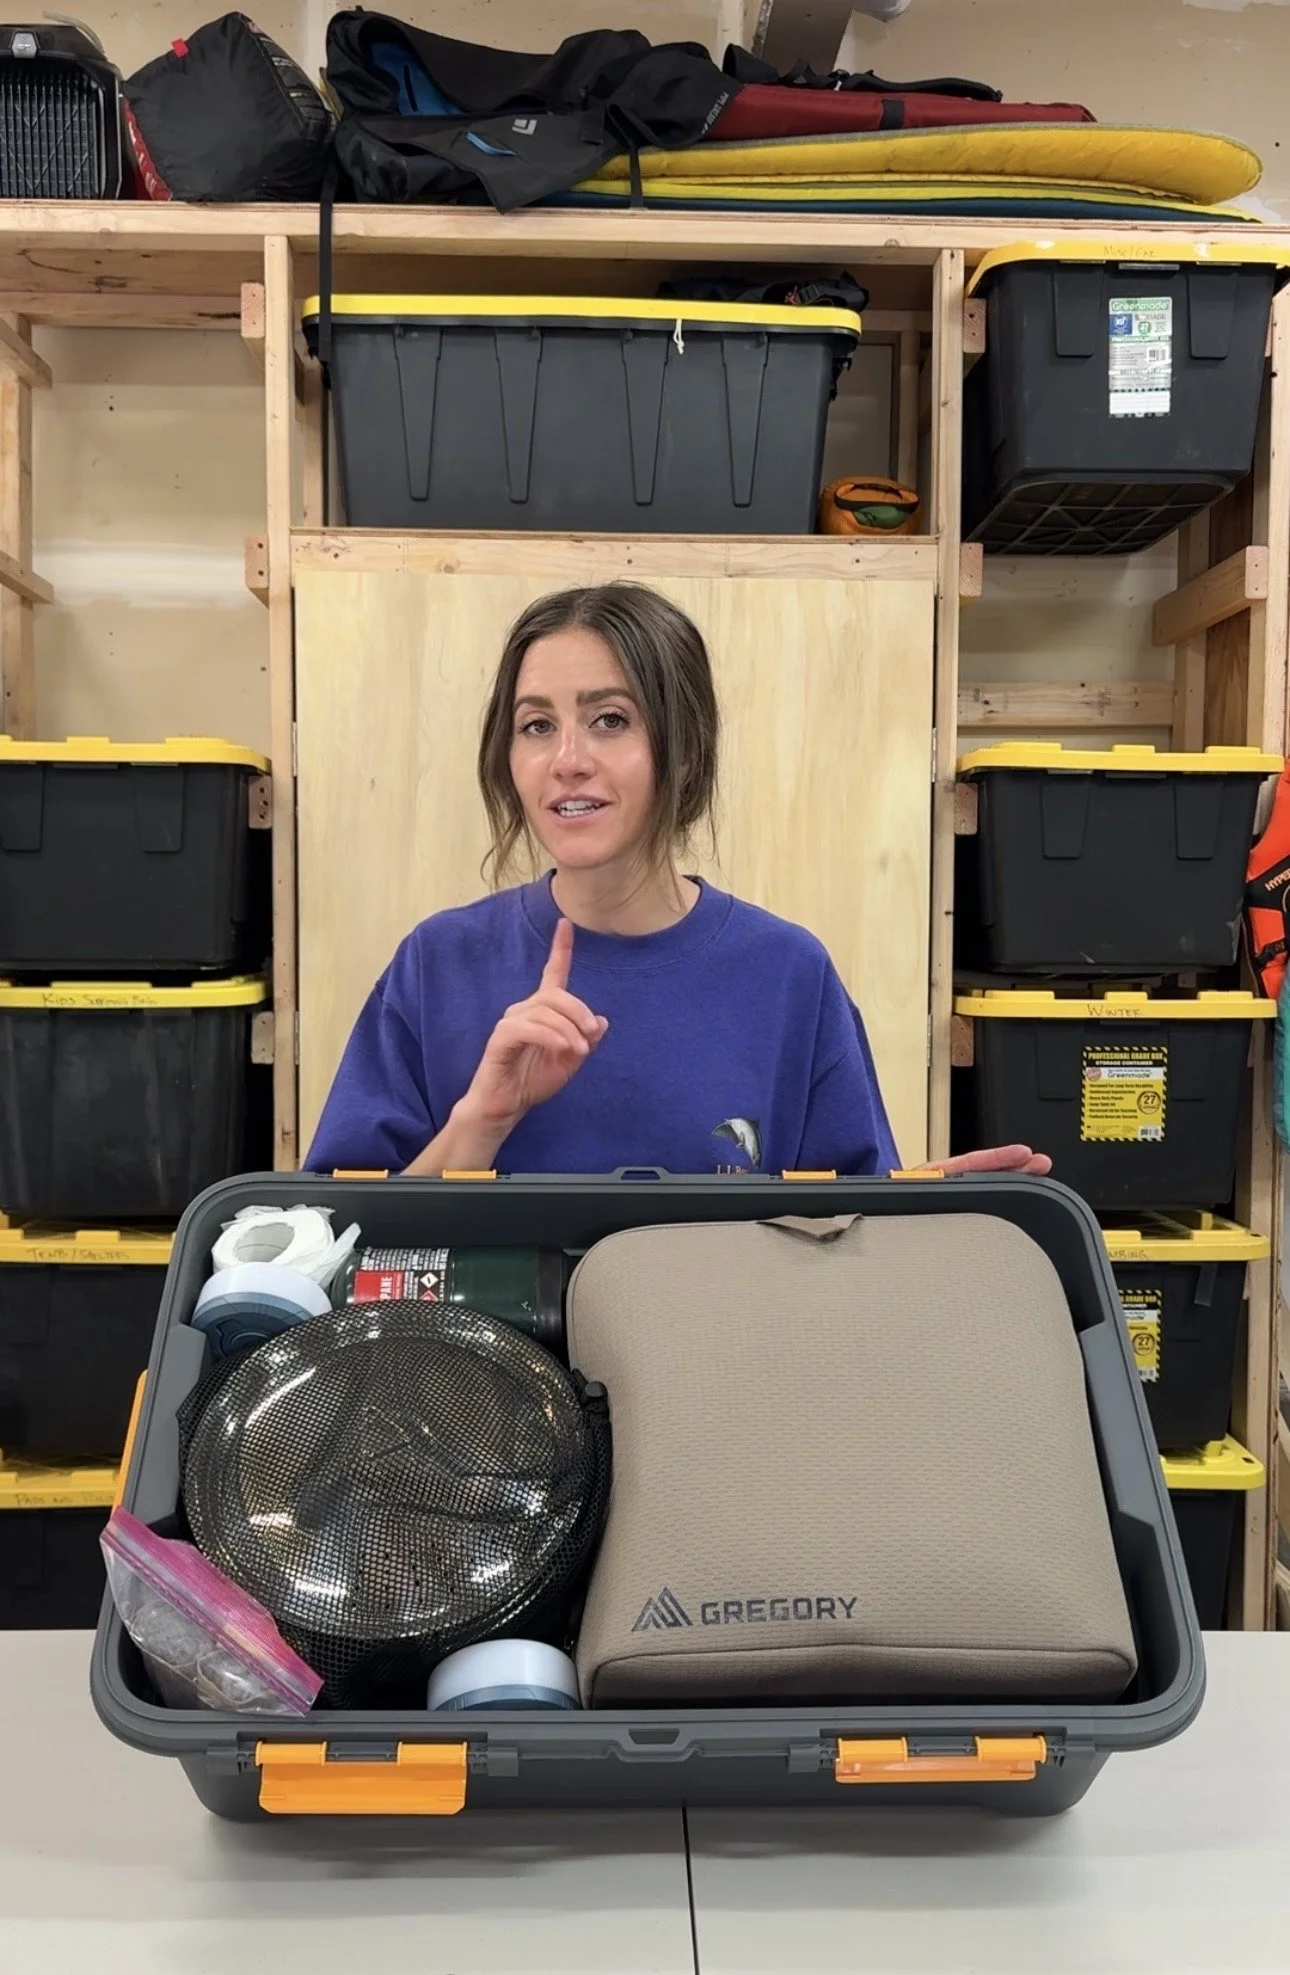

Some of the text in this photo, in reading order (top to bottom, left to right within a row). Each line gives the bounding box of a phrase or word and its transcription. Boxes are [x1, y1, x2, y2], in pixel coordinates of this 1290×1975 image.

[1111, 301, 1168, 311] Greenmade
[1143, 1095, 1156, 1104] 27
[380, 1276, 393, 1301] PANE
[1138, 1336, 1150, 1346] 27
[700, 1597, 858, 1626] GREGORY
